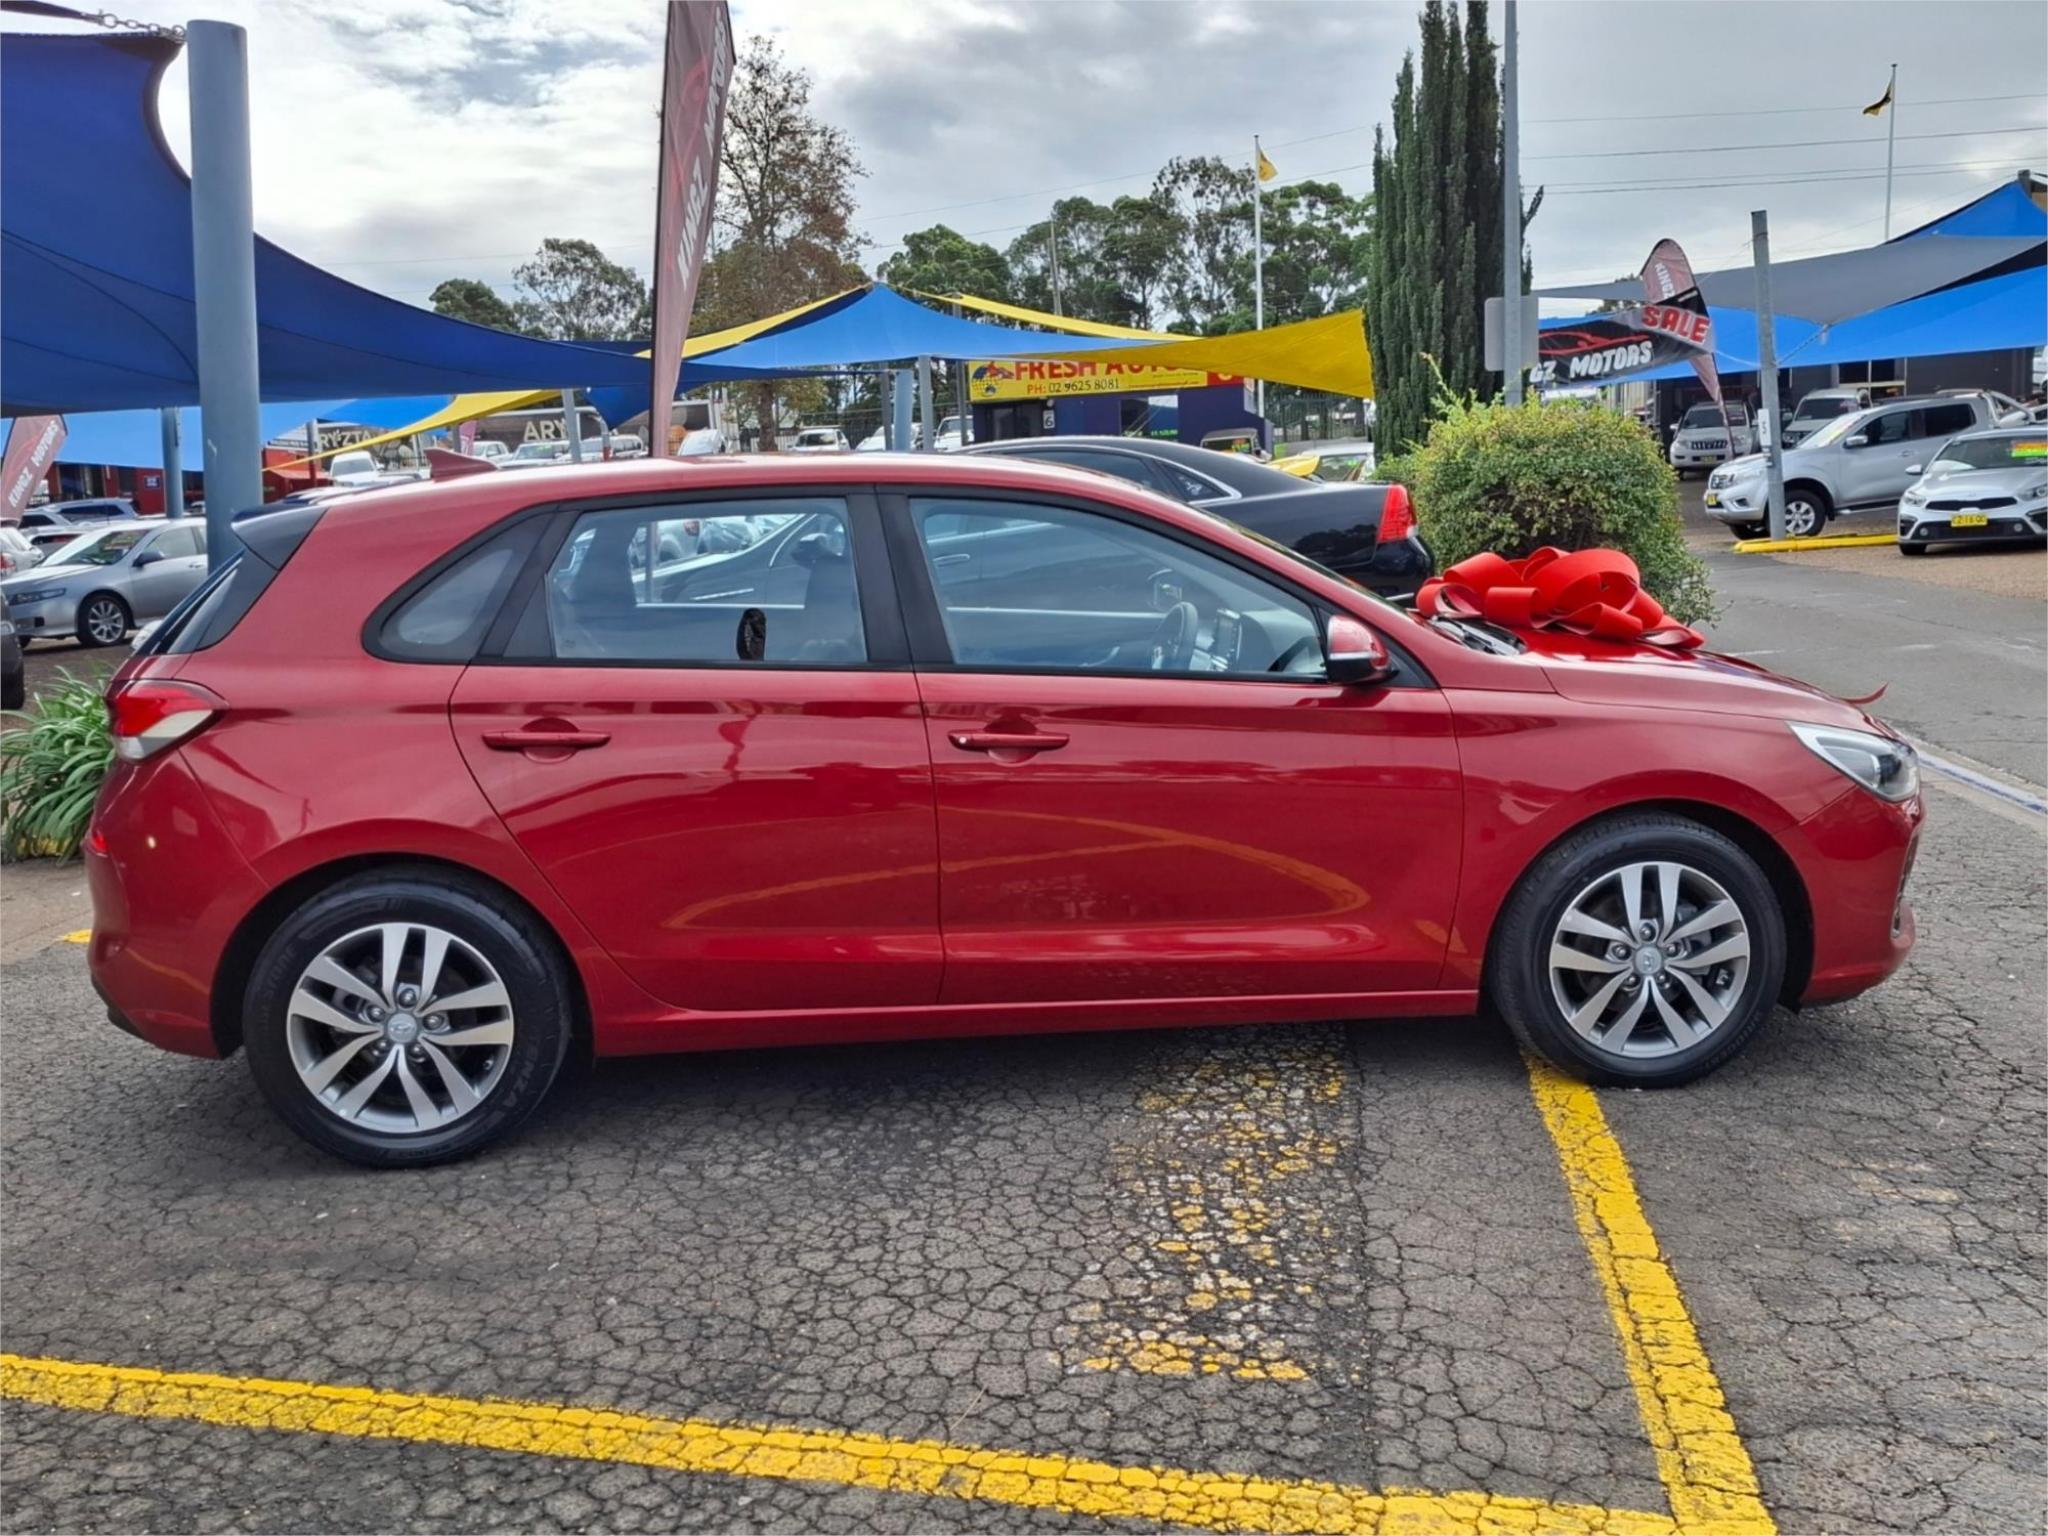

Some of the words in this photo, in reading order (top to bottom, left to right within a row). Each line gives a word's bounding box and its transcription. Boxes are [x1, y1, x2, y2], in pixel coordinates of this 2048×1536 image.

[1641, 304, 1710, 344] SALE
[1014, 361, 1097, 381] FRESH
[1569, 341, 1653, 378] MOTORS
[1027, 384, 1047, 395] PH:
[1049, 382, 1061, 393] 02
[1064, 380, 1092, 392] 9625
[1094, 378, 1119, 390] 8081
